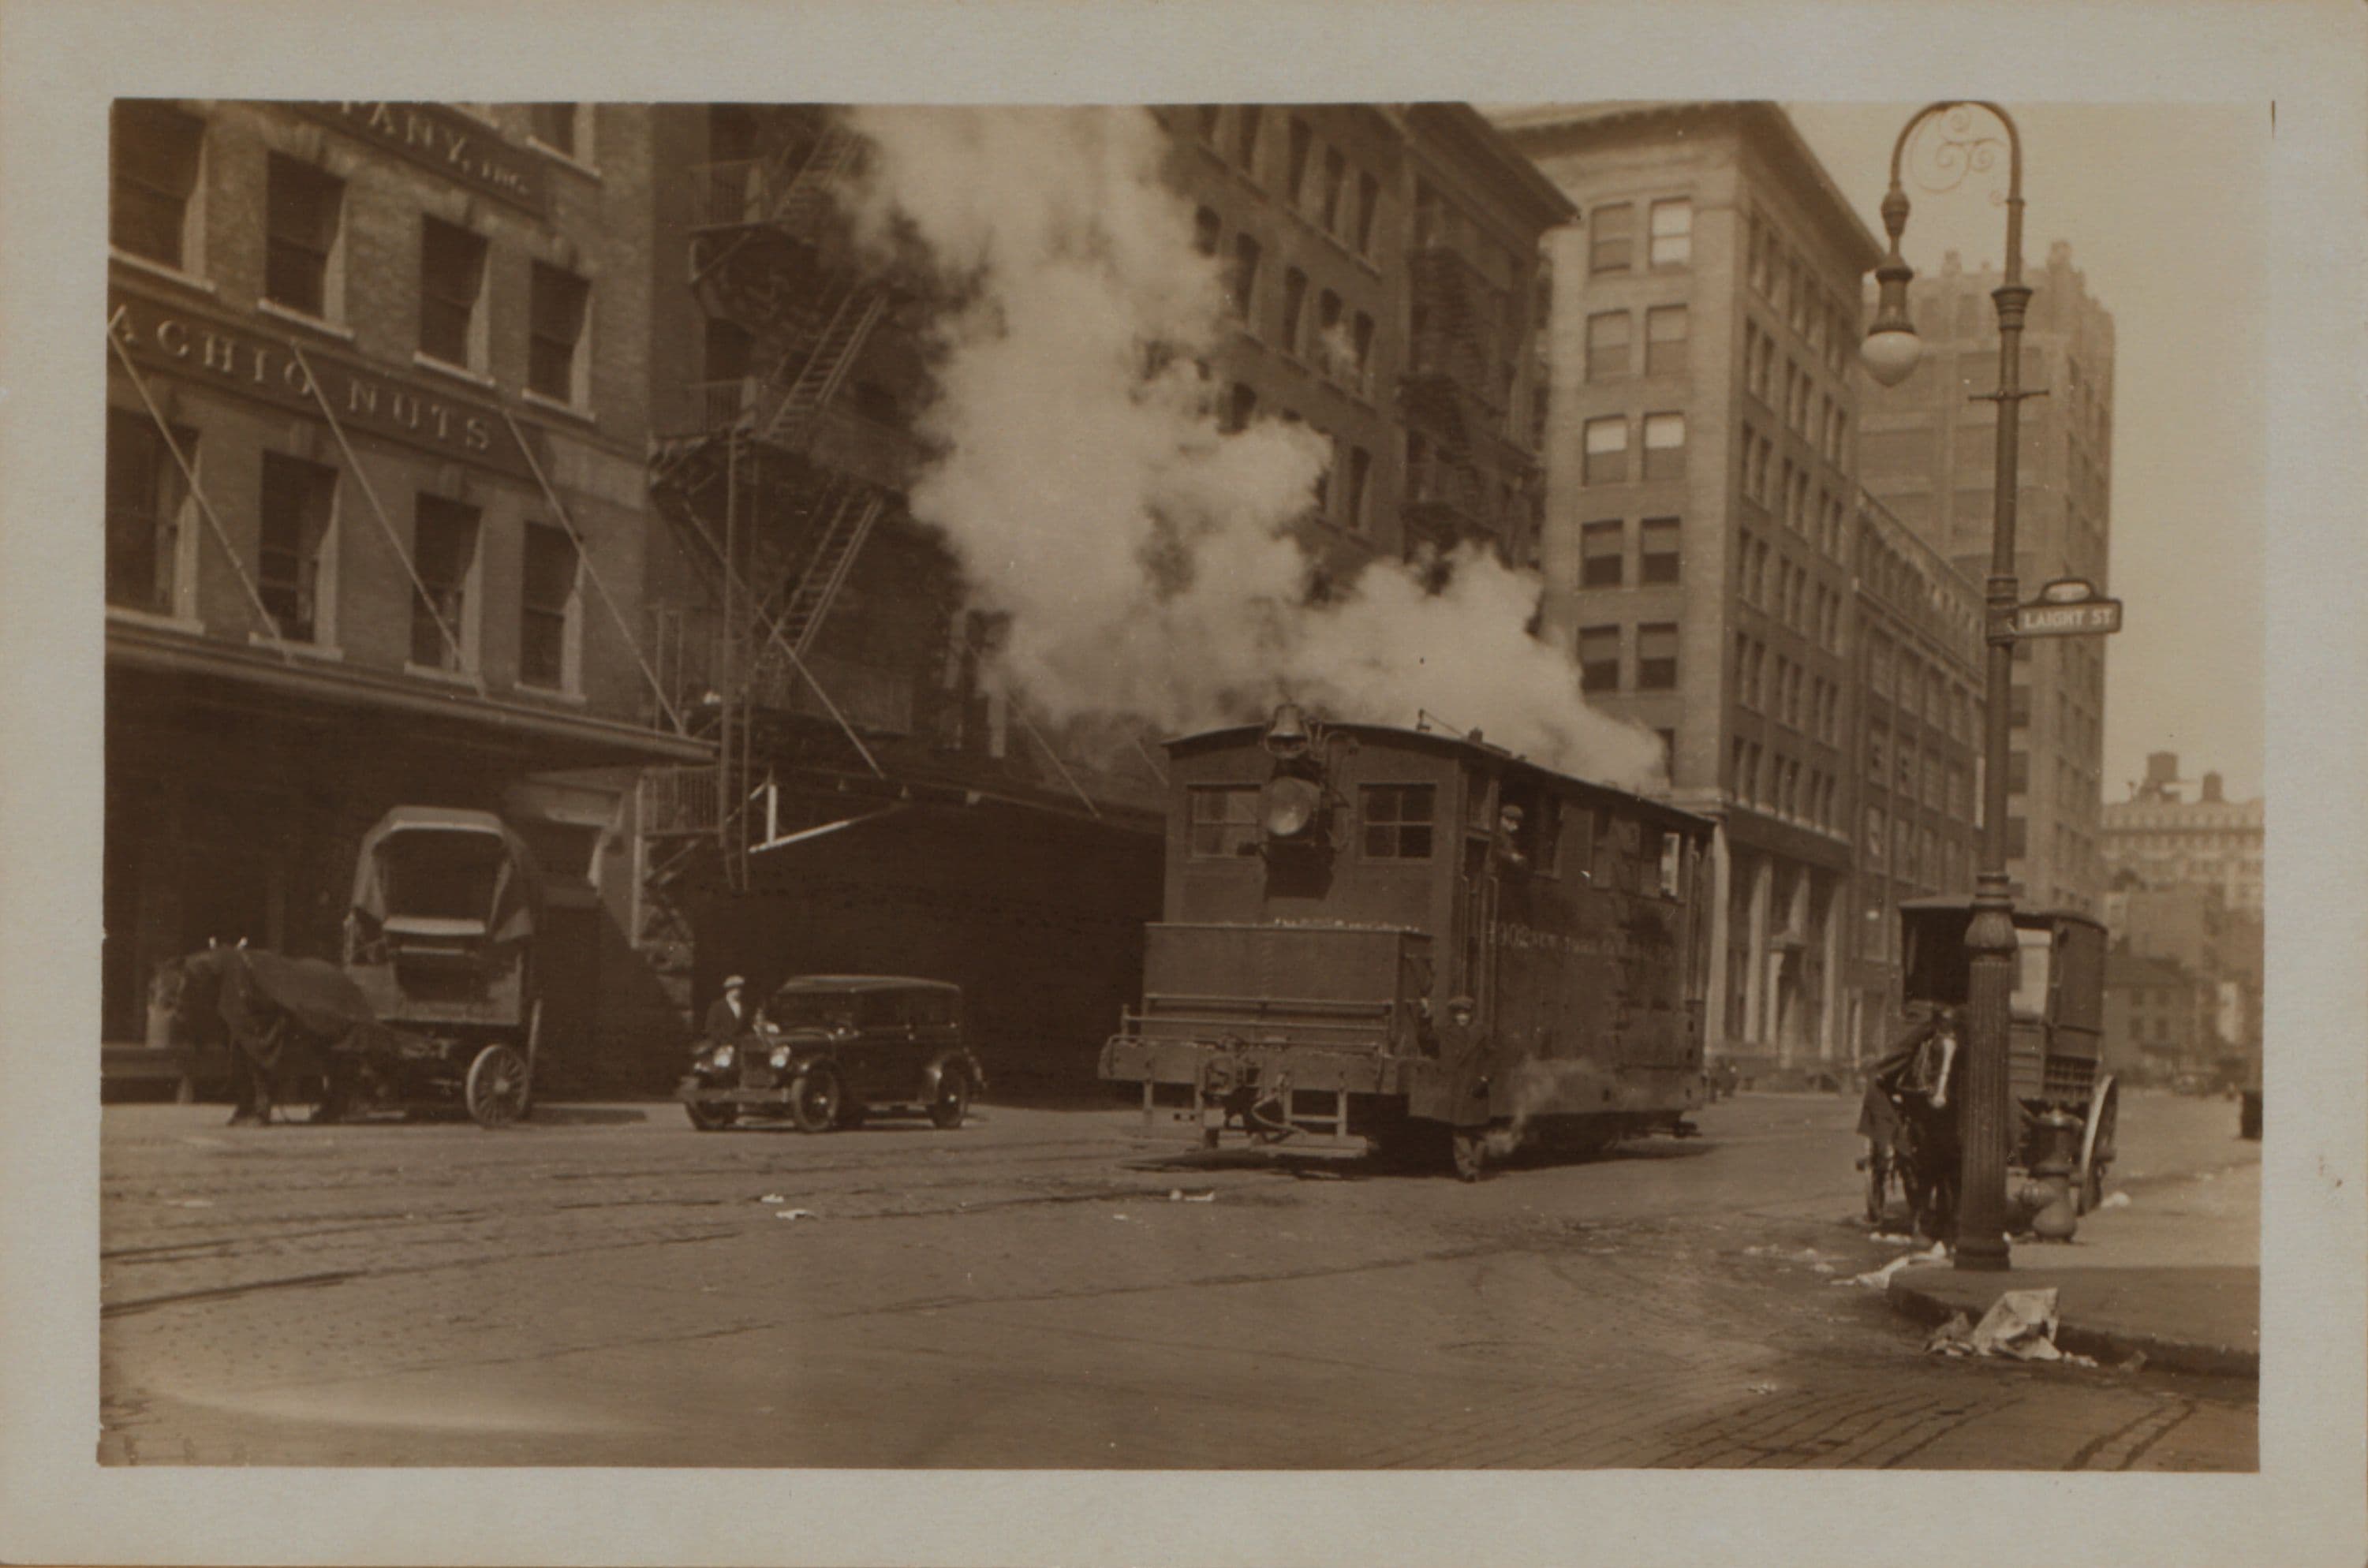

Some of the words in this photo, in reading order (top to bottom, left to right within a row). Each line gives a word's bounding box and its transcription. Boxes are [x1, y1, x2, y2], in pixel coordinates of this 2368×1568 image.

[347, 378, 491, 450] NUTS
[2023, 610, 2085, 629] LAIGHT
[2090, 607, 2113, 626] ST
